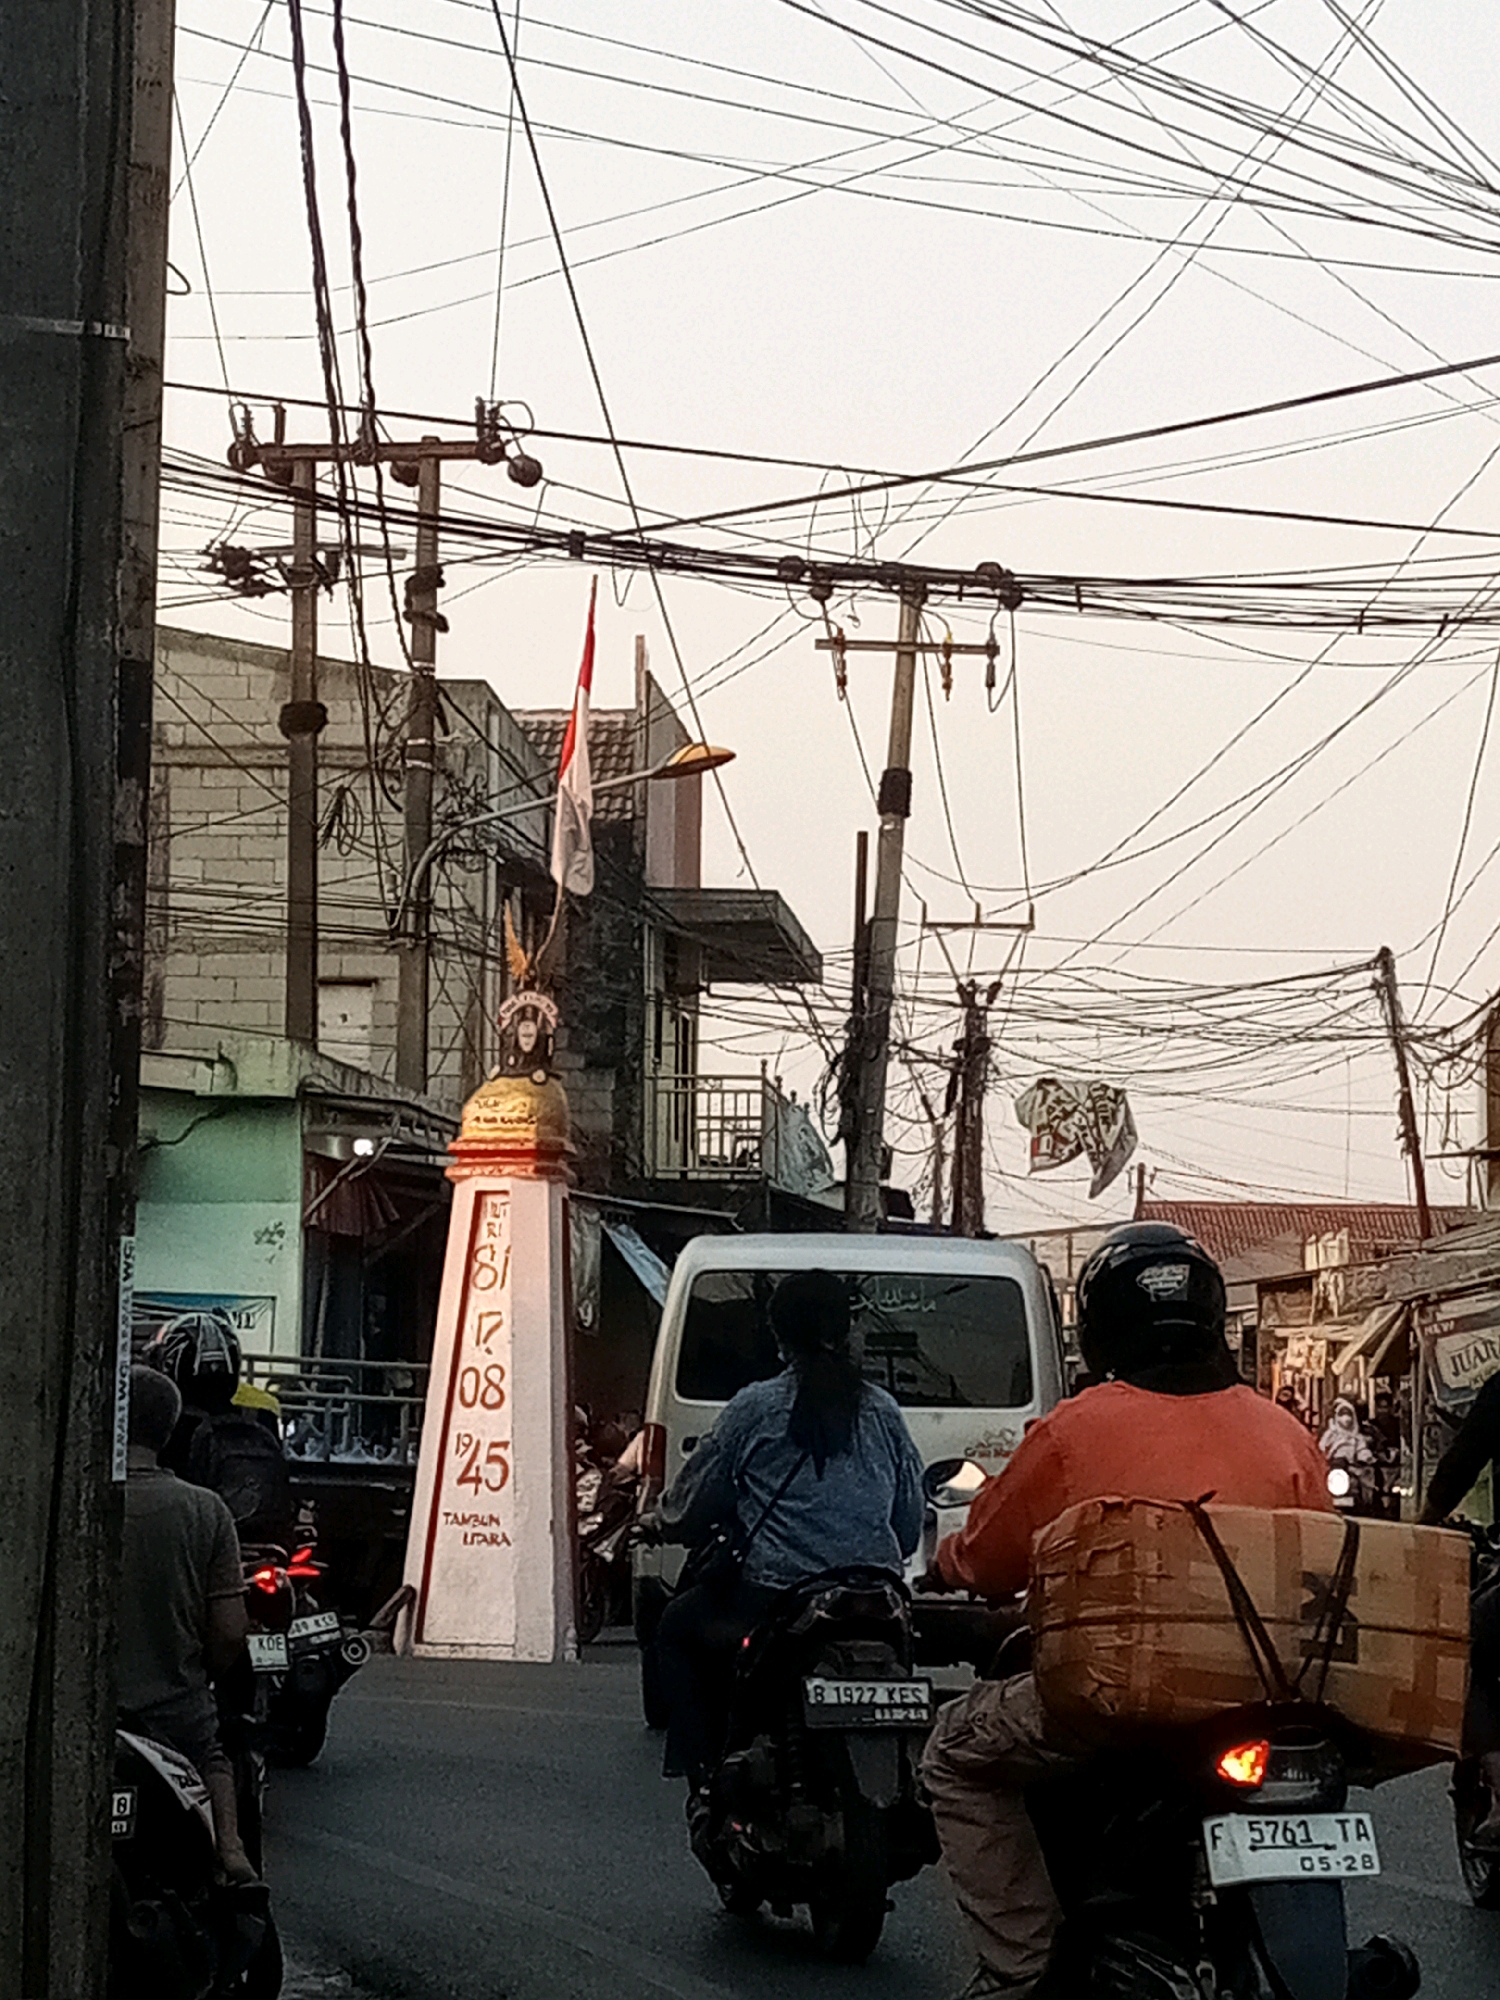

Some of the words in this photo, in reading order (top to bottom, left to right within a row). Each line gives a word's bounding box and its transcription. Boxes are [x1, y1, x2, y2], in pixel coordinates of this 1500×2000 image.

[460, 1363, 505, 1411] 08
[1210, 1822, 1224, 1850] F
[1248, 1819, 1313, 1846] 5761
[1335, 1818, 1371, 1843] TA
